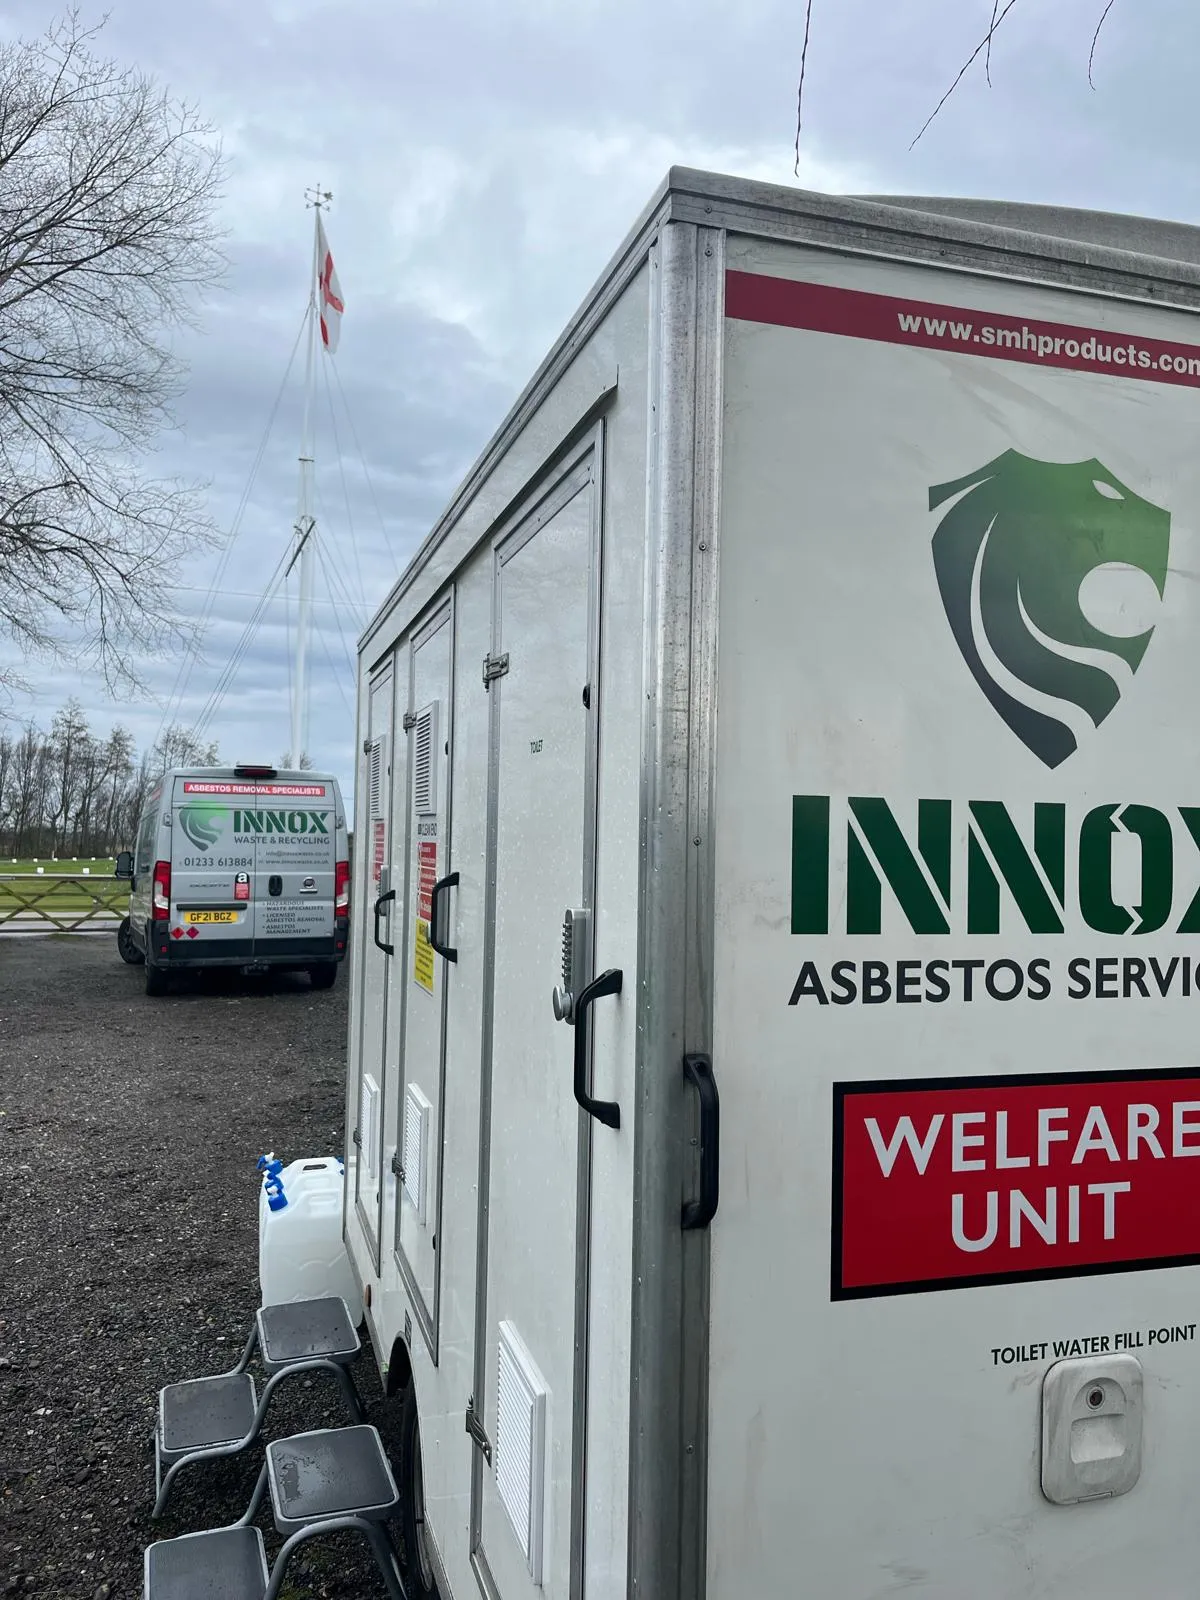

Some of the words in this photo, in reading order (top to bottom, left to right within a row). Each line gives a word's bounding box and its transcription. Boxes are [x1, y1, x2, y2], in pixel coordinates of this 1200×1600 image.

[188, 784, 231, 793] ASBESTOS
[232, 785, 271, 794] REMOVAL
[272, 786, 321, 795] SPECIALISTS
[234, 810, 329, 834] INNOX
[234, 836, 267, 845] WASTE
[270, 836, 277, 844] &
[278, 836, 330, 845] RECYCLING
[184, 857, 214, 867] 01233
[217, 857, 253, 867] 613884
[791, 795, 1200, 935] INNO
[237, 872, 248, 883] a
[190, 912, 212, 922] GF21
[214, 912, 232, 921] BGZ
[788, 958, 1051, 1006] ASBESTOS
[1068, 957, 1200, 999] SERVI
[864, 1101, 1200, 1177] WELFARE
[951, 1181, 1131, 1252] UNIT
[991, 1343, 1048, 1365] TOILET
[1053, 1336, 1110, 1358] WATER
[1115, 1331, 1143, 1350] FILL
[1148, 1324, 1197, 1345] POINT
